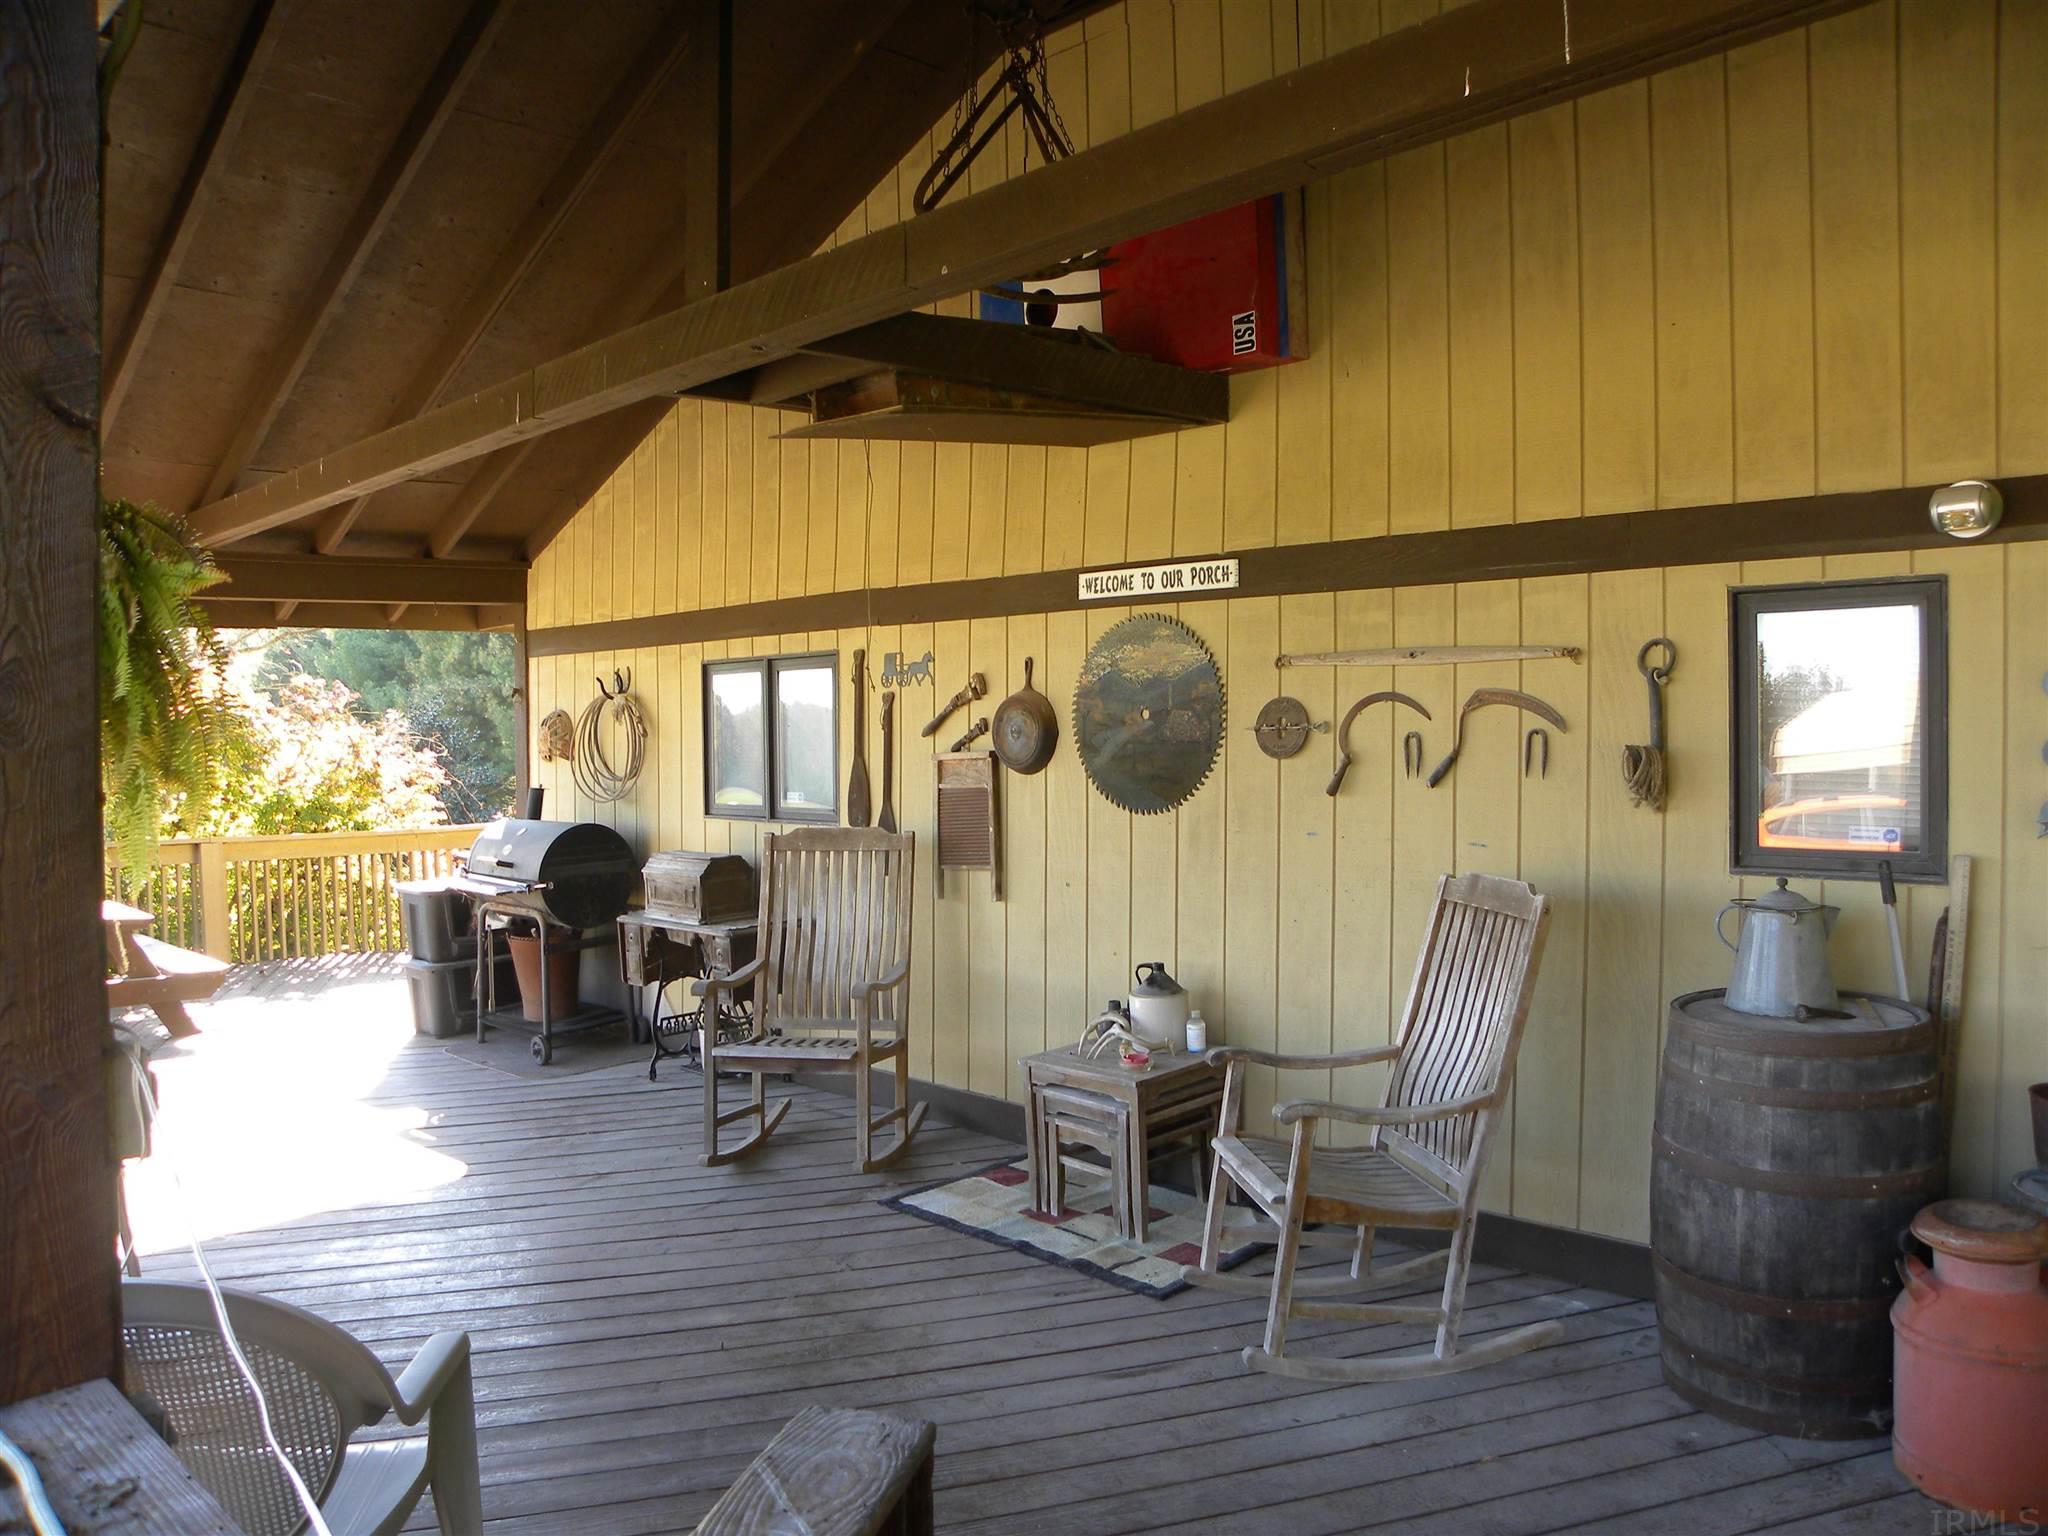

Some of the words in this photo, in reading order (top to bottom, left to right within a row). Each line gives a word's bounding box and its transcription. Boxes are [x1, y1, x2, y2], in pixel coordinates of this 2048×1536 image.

[1233, 311, 1256, 354] USA
[1085, 574, 1134, 594] WELCOME
[1141, 572, 1155, 590] TO
[1161, 569, 1184, 588] OUR
[1190, 564, 1230, 586] PORCH
